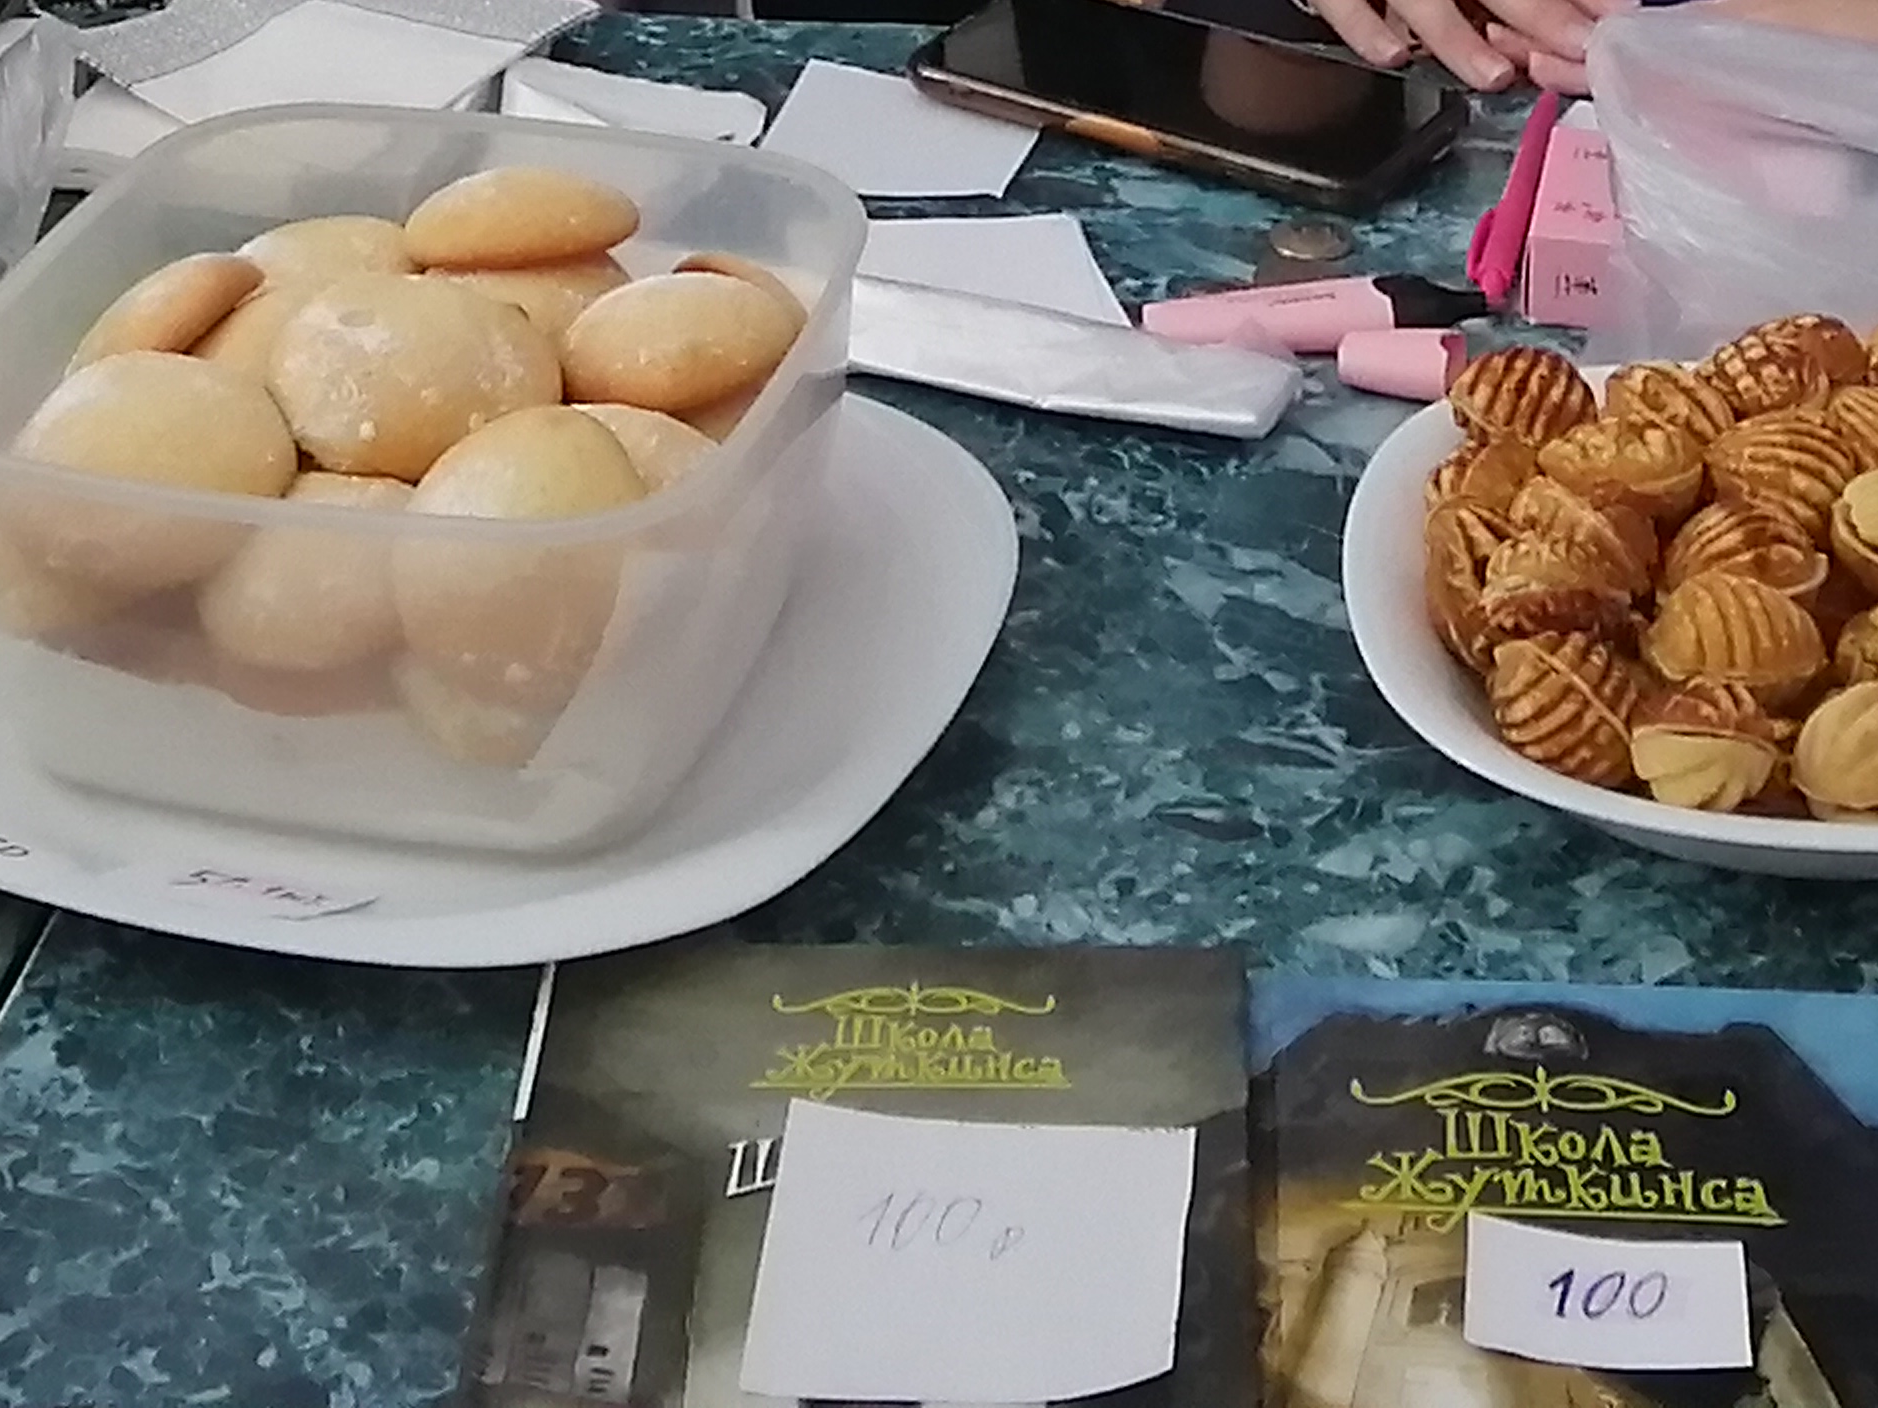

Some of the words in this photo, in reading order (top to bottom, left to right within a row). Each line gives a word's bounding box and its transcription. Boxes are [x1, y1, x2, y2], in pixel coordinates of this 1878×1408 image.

[834, 1014, 996, 1051] Школа
[764, 1044, 1068, 1099] Жуткинса
[1435, 1107, 1672, 1168] Школа
[1359, 1148, 1780, 1233] Жуткинса
[1549, 1267, 1670, 1320] 100
